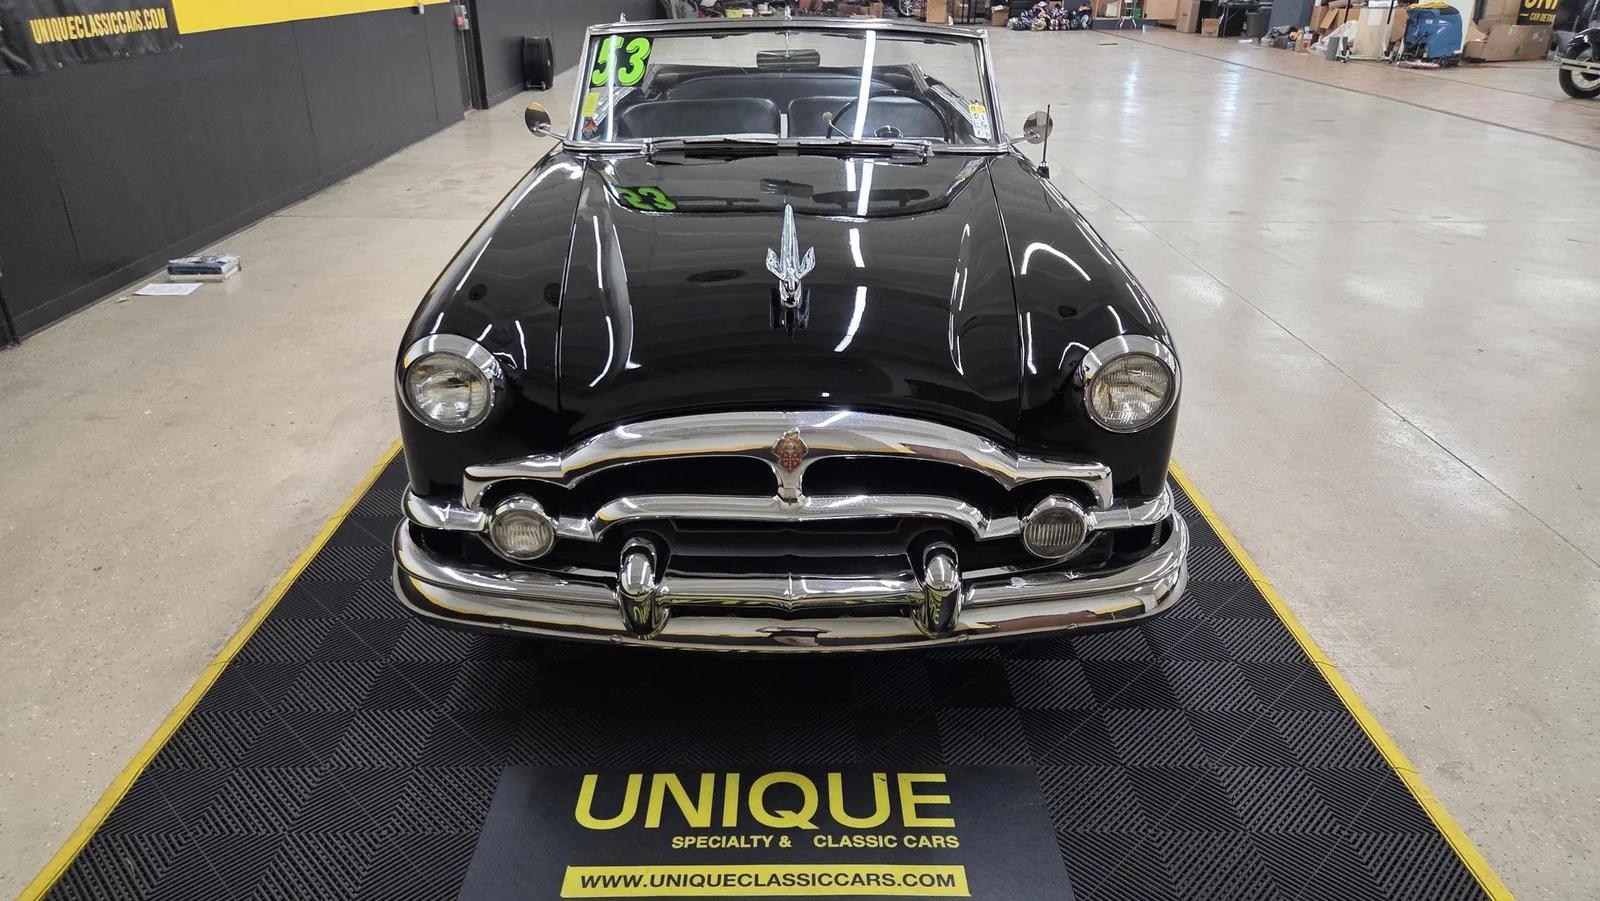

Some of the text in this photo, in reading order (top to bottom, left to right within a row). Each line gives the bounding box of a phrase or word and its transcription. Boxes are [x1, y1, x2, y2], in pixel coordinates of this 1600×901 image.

[30, 8, 168, 44] UNIQUECLASSICCARS.COM
[592, 36, 650, 86] 53
[574, 771, 956, 830] UNIQUE
[671, 834, 960, 849] SPECIALTY & CLASSIC CARS
[580, 873, 956, 889] WWW.UNIQUECLASSICCARS.COM
